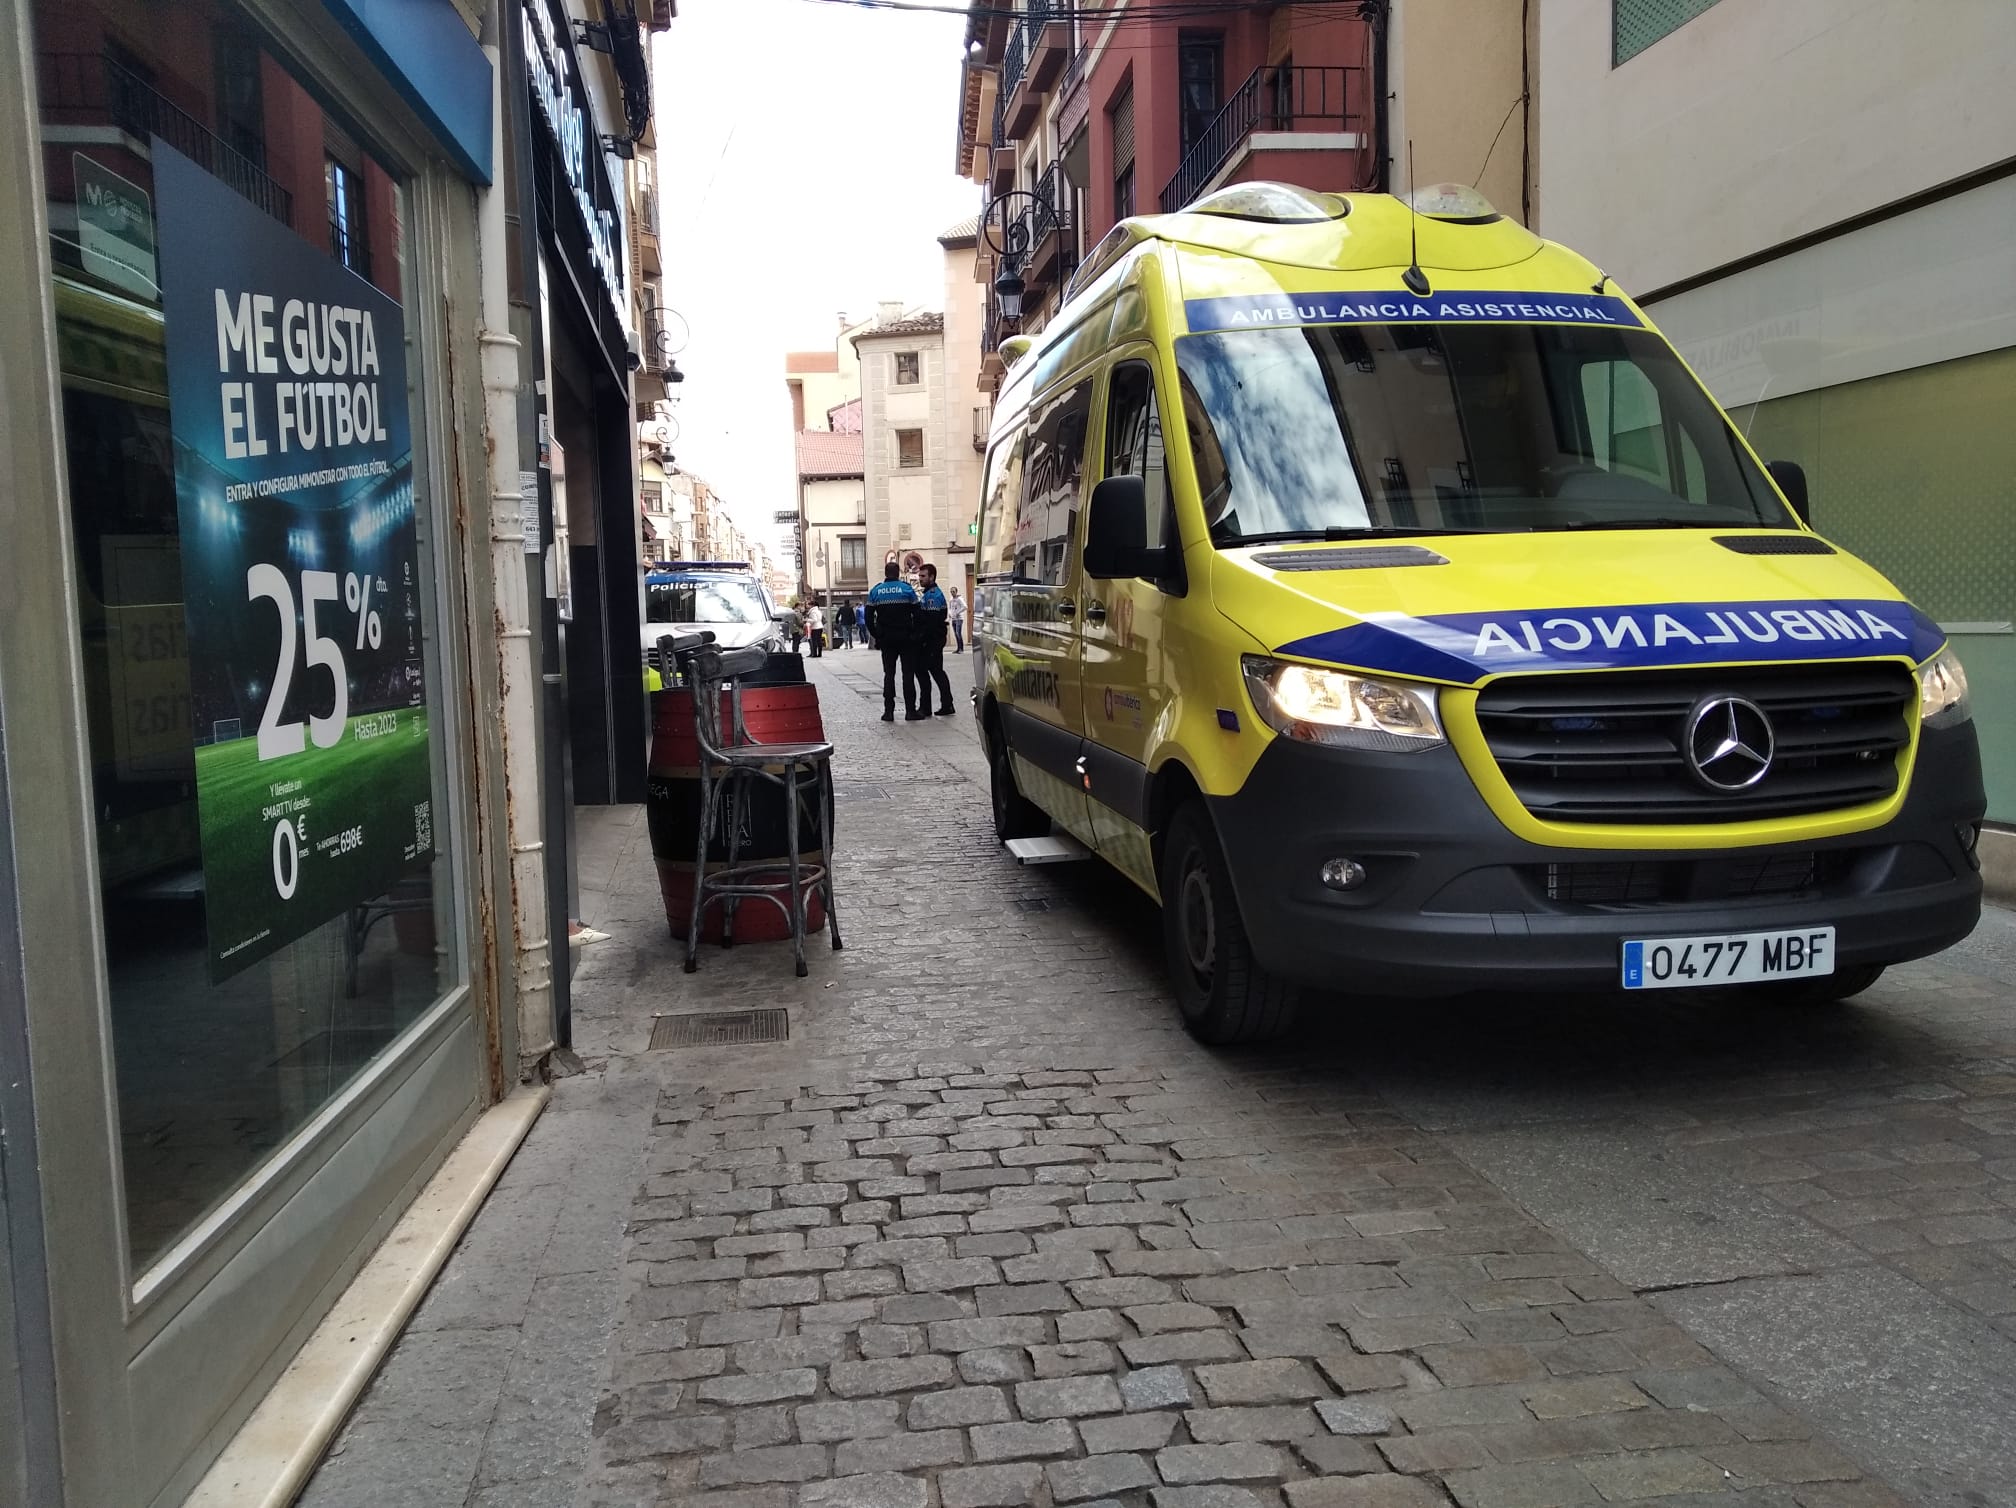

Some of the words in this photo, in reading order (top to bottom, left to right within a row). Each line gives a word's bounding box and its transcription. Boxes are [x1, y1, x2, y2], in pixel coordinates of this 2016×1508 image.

[1230, 303, 1431, 323] AMBULANCIA
[1439, 303, 1617, 322] ASISTENCIAL
[215, 288, 278, 373] ME
[282, 299, 379, 376] GUSTA
[221, 382, 267, 459] EL
[276, 382, 386, 453] FÚTBOL
[226, 482, 252, 503] ENTRA
[252, 481, 259, 498] Y
[258, 475, 299, 497] CONFIGURA
[299, 469, 336, 489] MIMOVISTAR
[336, 466, 348, 482] CON
[348, 464, 363, 479] TODO
[363, 463, 369, 476] EL
[247, 563, 382, 761] 25%
[354, 718, 378, 742] Hasta
[377, 713, 397, 736] 2023
[262, 803, 284, 822] SMART
[282, 799, 293, 814] TV
[298, 847, 309, 859] mes
[340, 825, 363, 854] 698€
[1629, 969, 1638, 980] E
[1651, 941, 1748, 981] 0477
[1762, 933, 1828, 973] MBF
